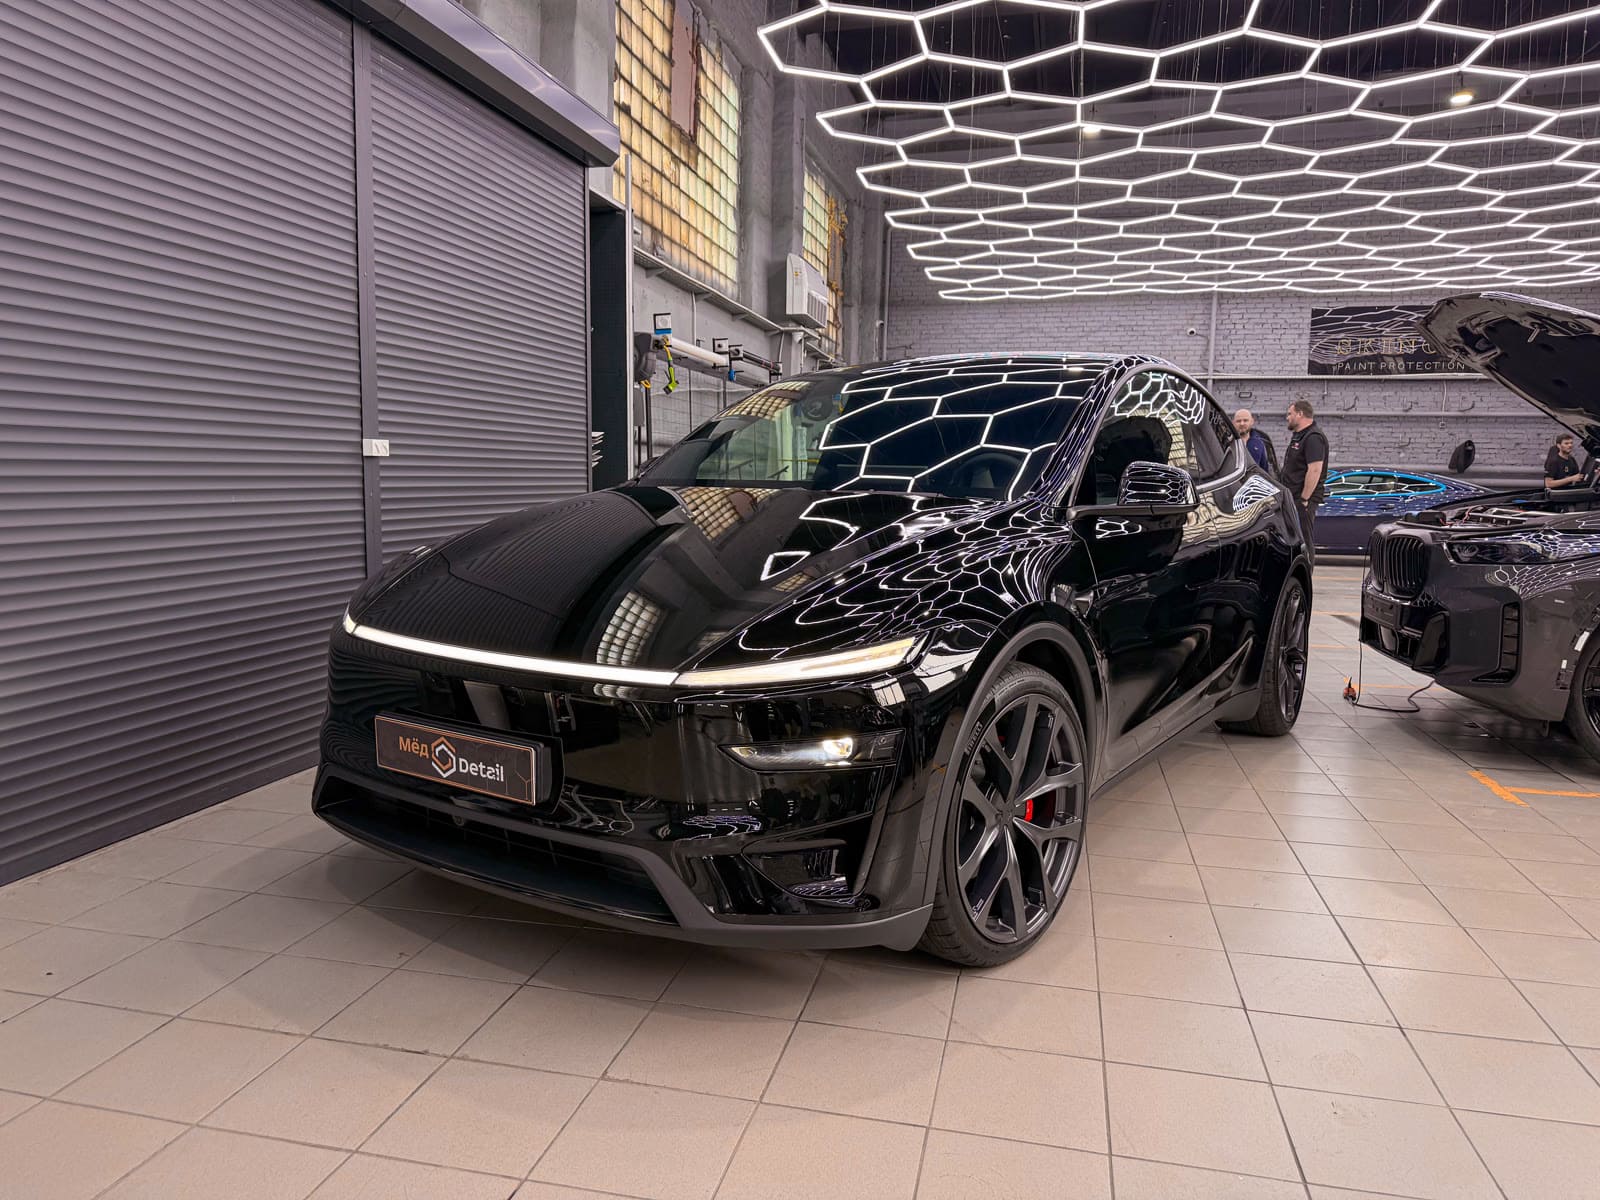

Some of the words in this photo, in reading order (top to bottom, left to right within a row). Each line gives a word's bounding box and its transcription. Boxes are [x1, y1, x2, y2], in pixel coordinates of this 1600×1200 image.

[1337, 361, 1375, 370] PAINT
[1380, 361, 1465, 370] PROTECTION
[399, 735, 430, 759] Мёд
[459, 757, 504, 782] Detail
